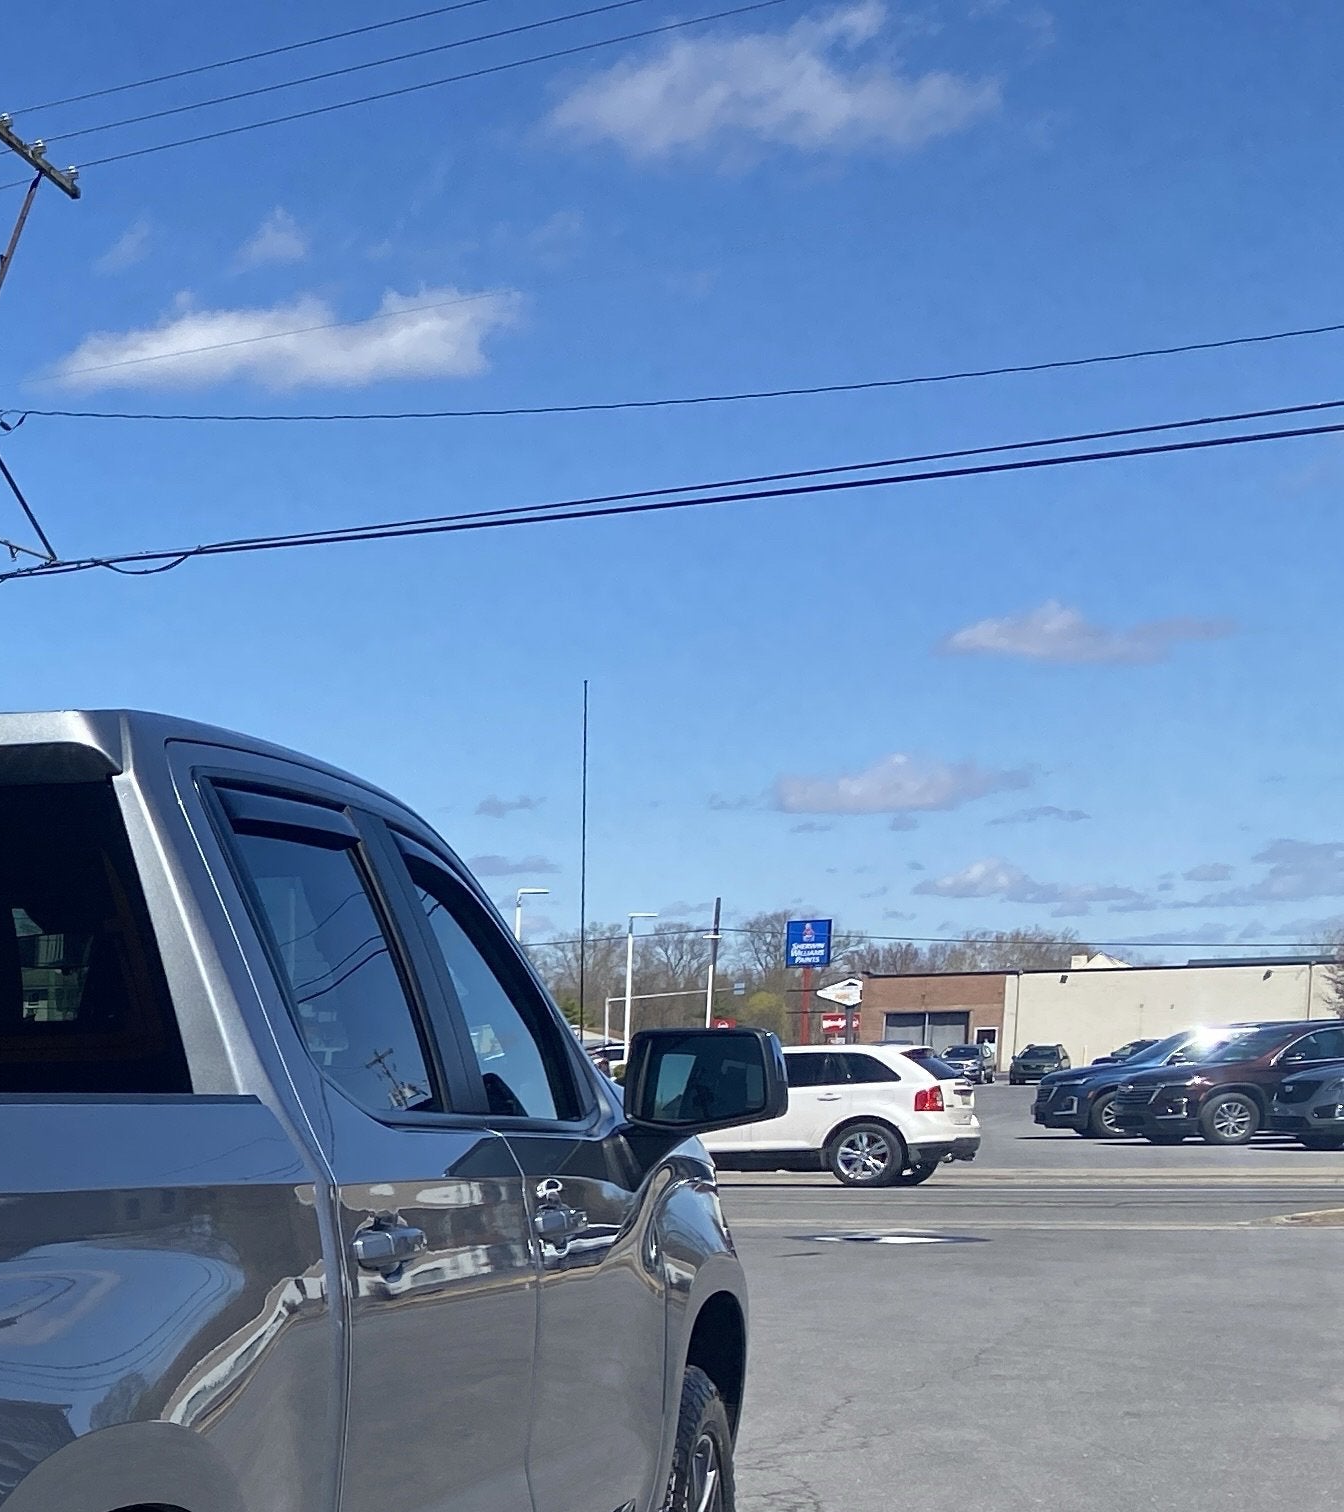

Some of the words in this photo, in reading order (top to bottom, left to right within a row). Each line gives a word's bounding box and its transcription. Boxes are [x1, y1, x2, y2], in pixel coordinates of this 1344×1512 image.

[791, 942, 825, 951] SHERWIN
[790, 949, 825, 957] WILLIAMS
[794, 956, 820, 964] PAINTS
